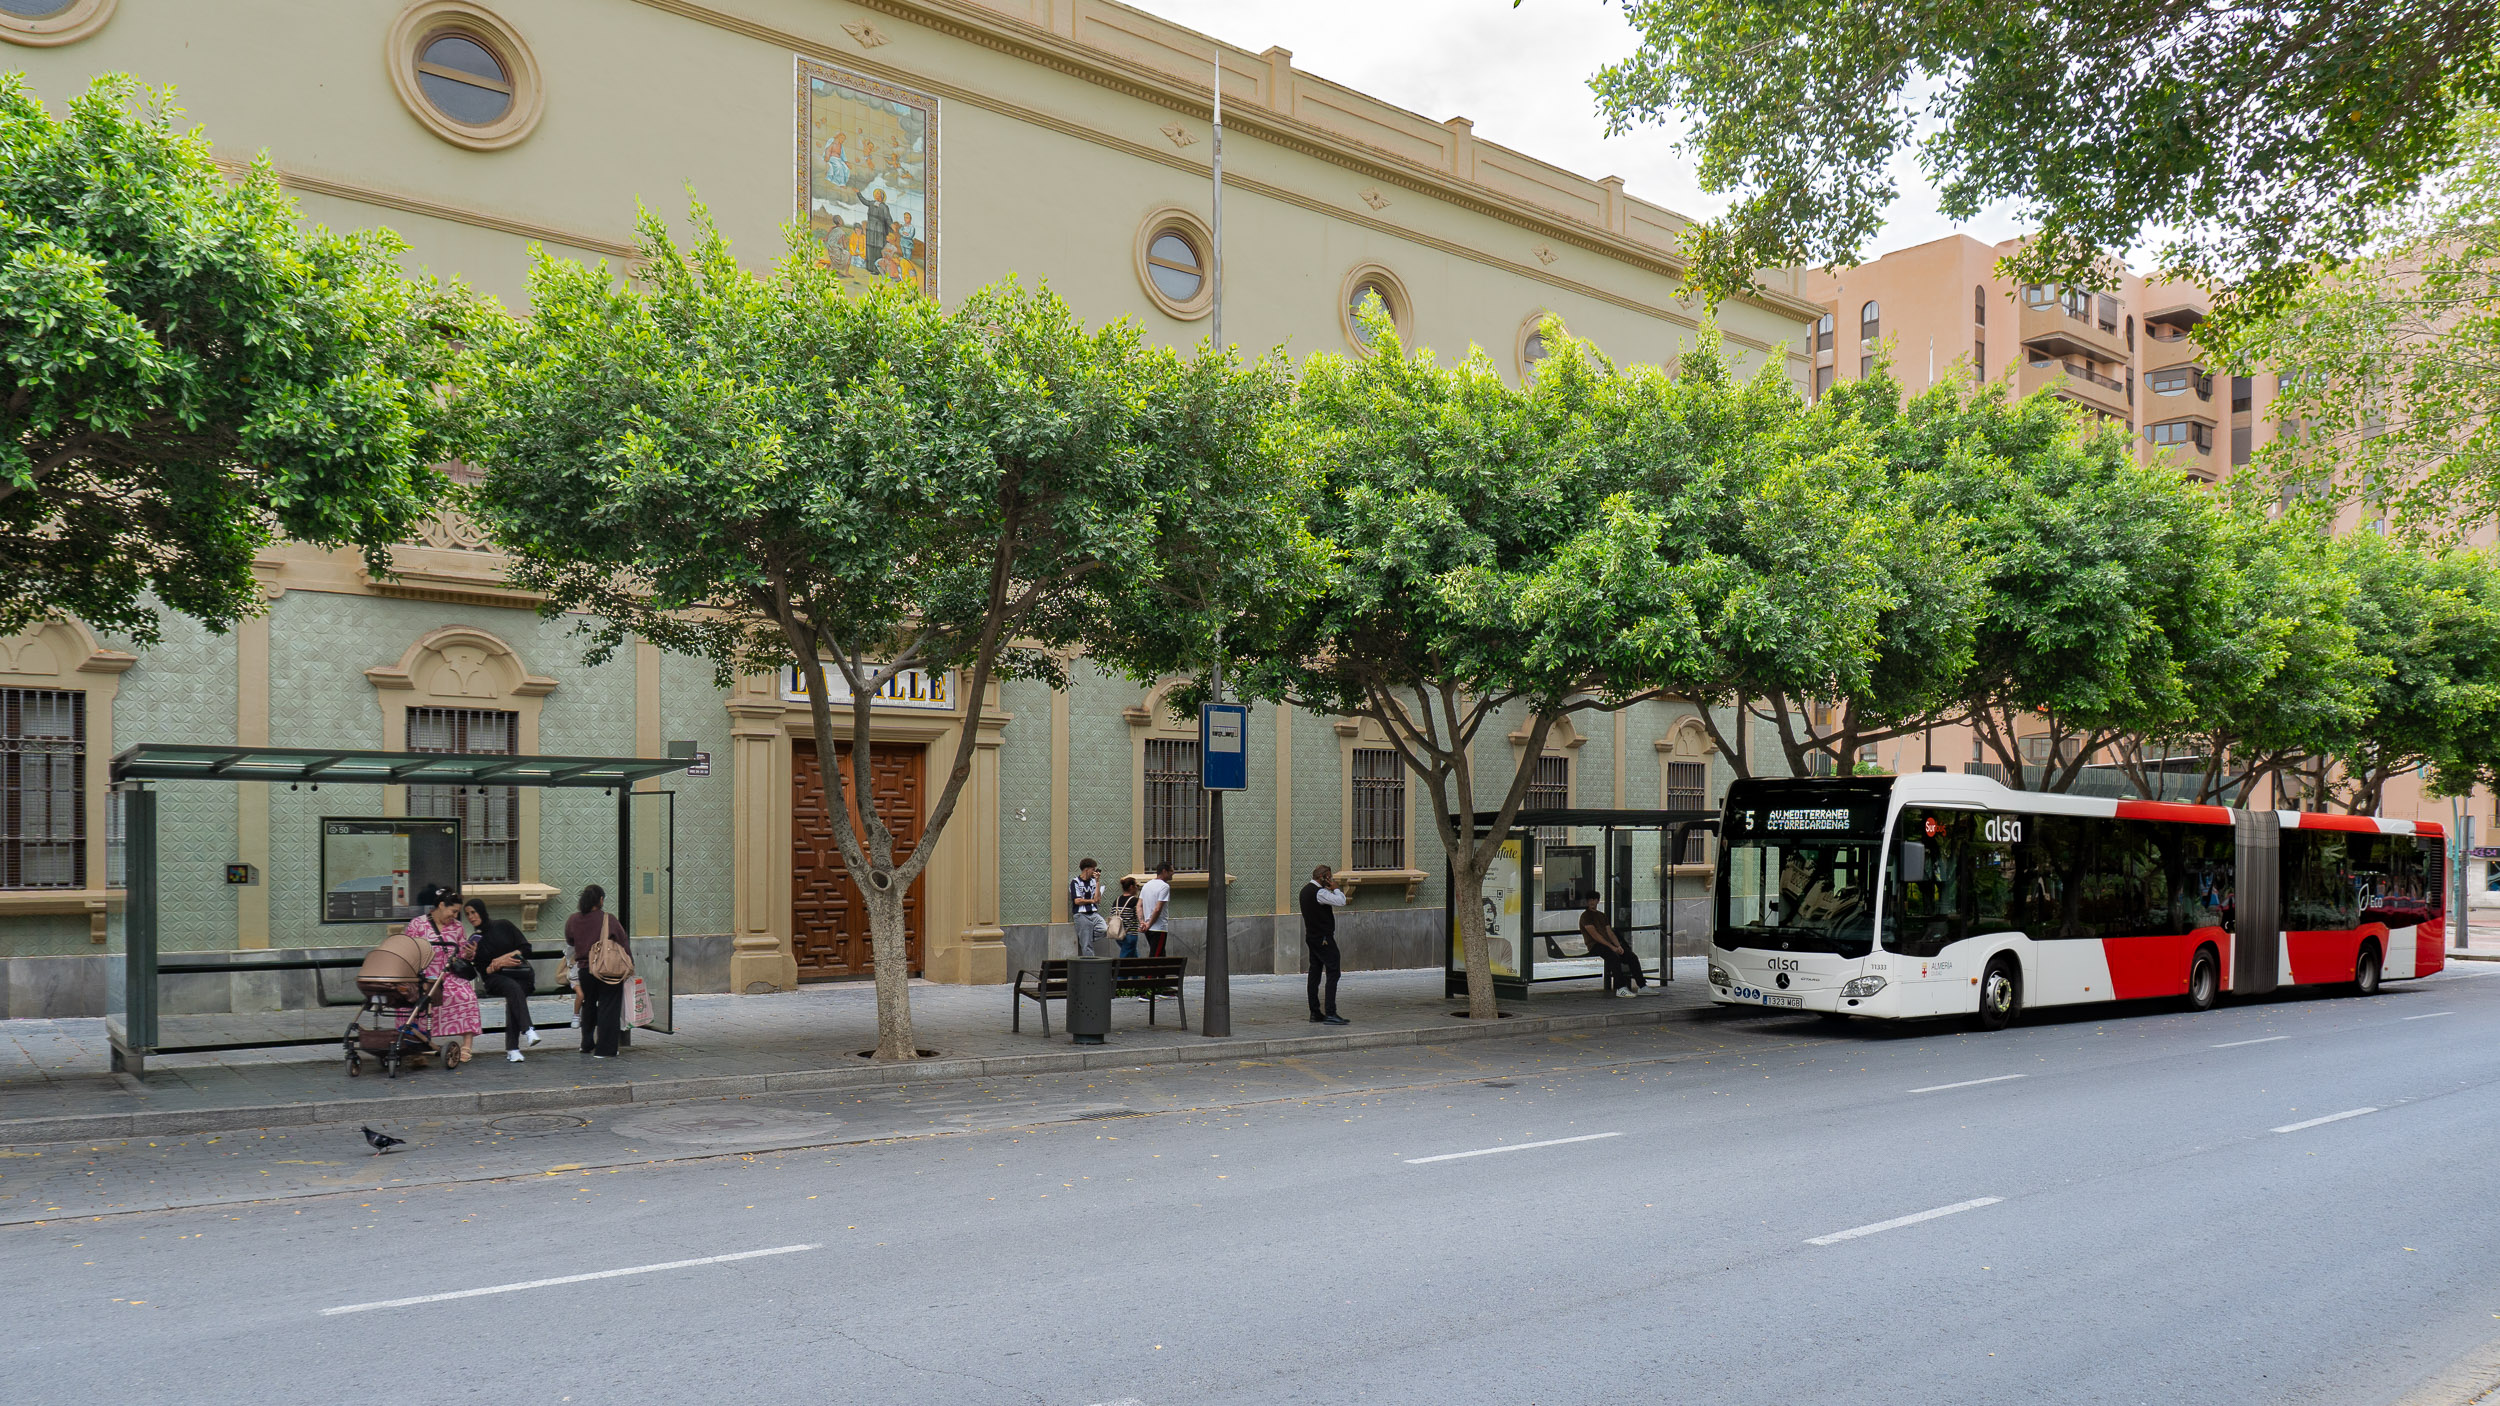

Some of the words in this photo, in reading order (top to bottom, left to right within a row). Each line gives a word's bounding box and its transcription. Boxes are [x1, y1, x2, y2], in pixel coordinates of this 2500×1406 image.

[1745, 810, 1755, 830] 5
[1769, 809, 1849, 820] AV.MEDITERRANEO
[338, 826, 349, 834] 50
[1767, 820, 1850, 830] CCTORRECARDENAS
[1985, 815, 2022, 843] alsa
[2370, 895, 2383, 908] Eco
[1767, 957, 1799, 971] alsa
[1768, 997, 1785, 1005] 1323
[1787, 998, 1801, 1007] MGB
